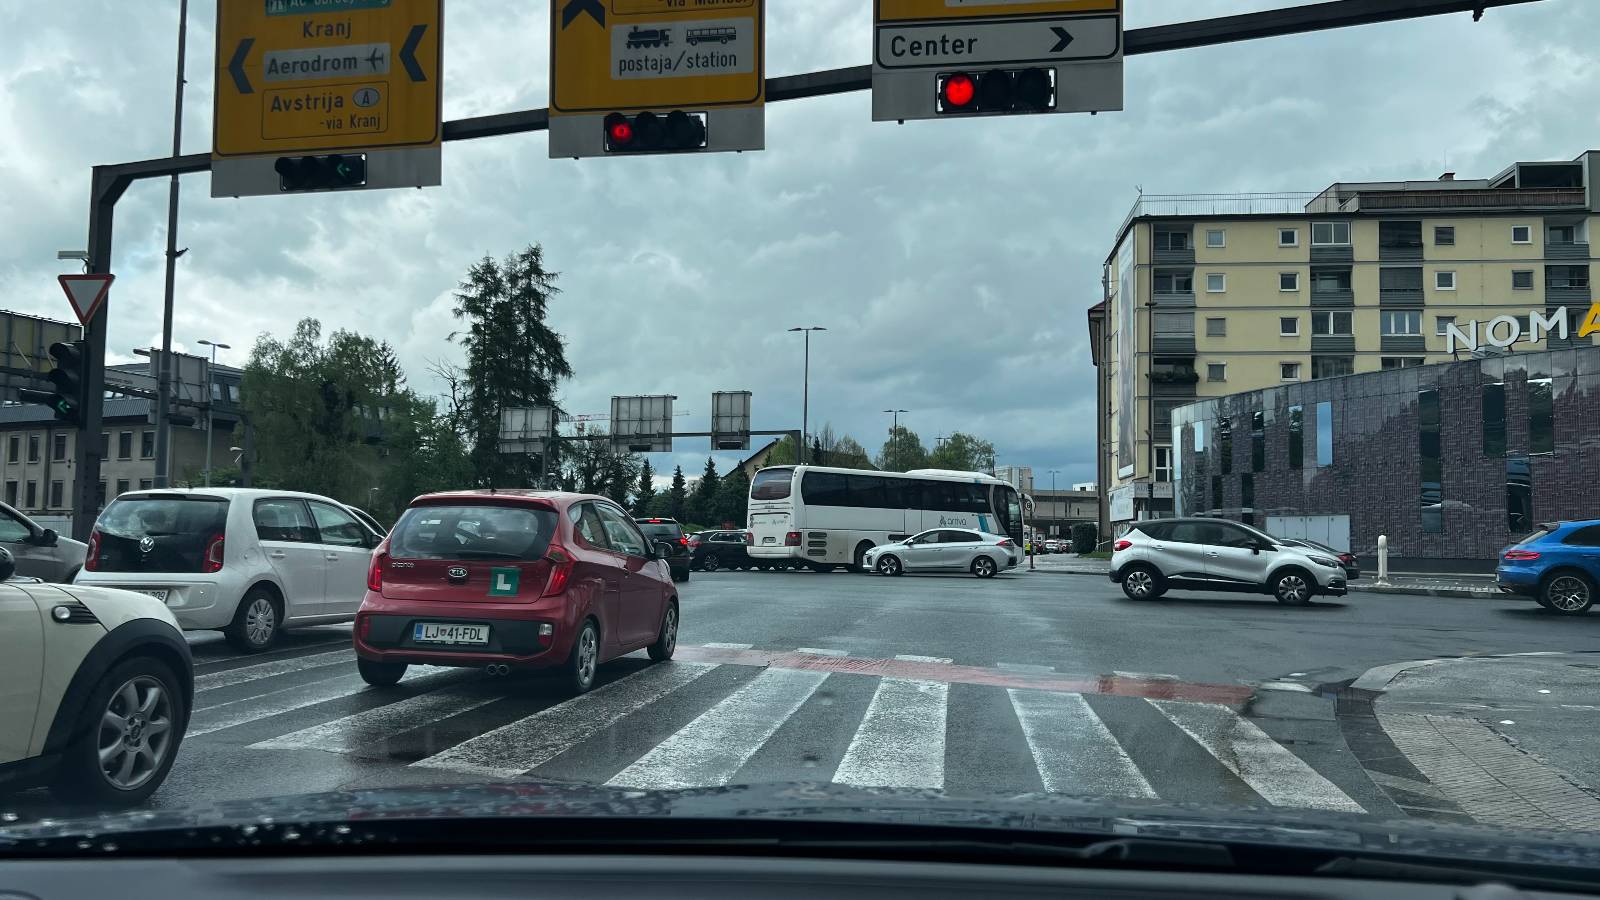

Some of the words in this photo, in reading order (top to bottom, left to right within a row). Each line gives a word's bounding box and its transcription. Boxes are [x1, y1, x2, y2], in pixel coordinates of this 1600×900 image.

[303, 18, 351, 38] Kranj
[891, 35, 978, 57] Center
[267, 55, 358, 75] Aerodrom
[619, 51, 737, 76] postaja/station
[270, 92, 344, 113] Avstrija
[362, 91, 370, 105] A
[350, 113, 381, 130] Kranj
[496, 573, 511, 591] L
